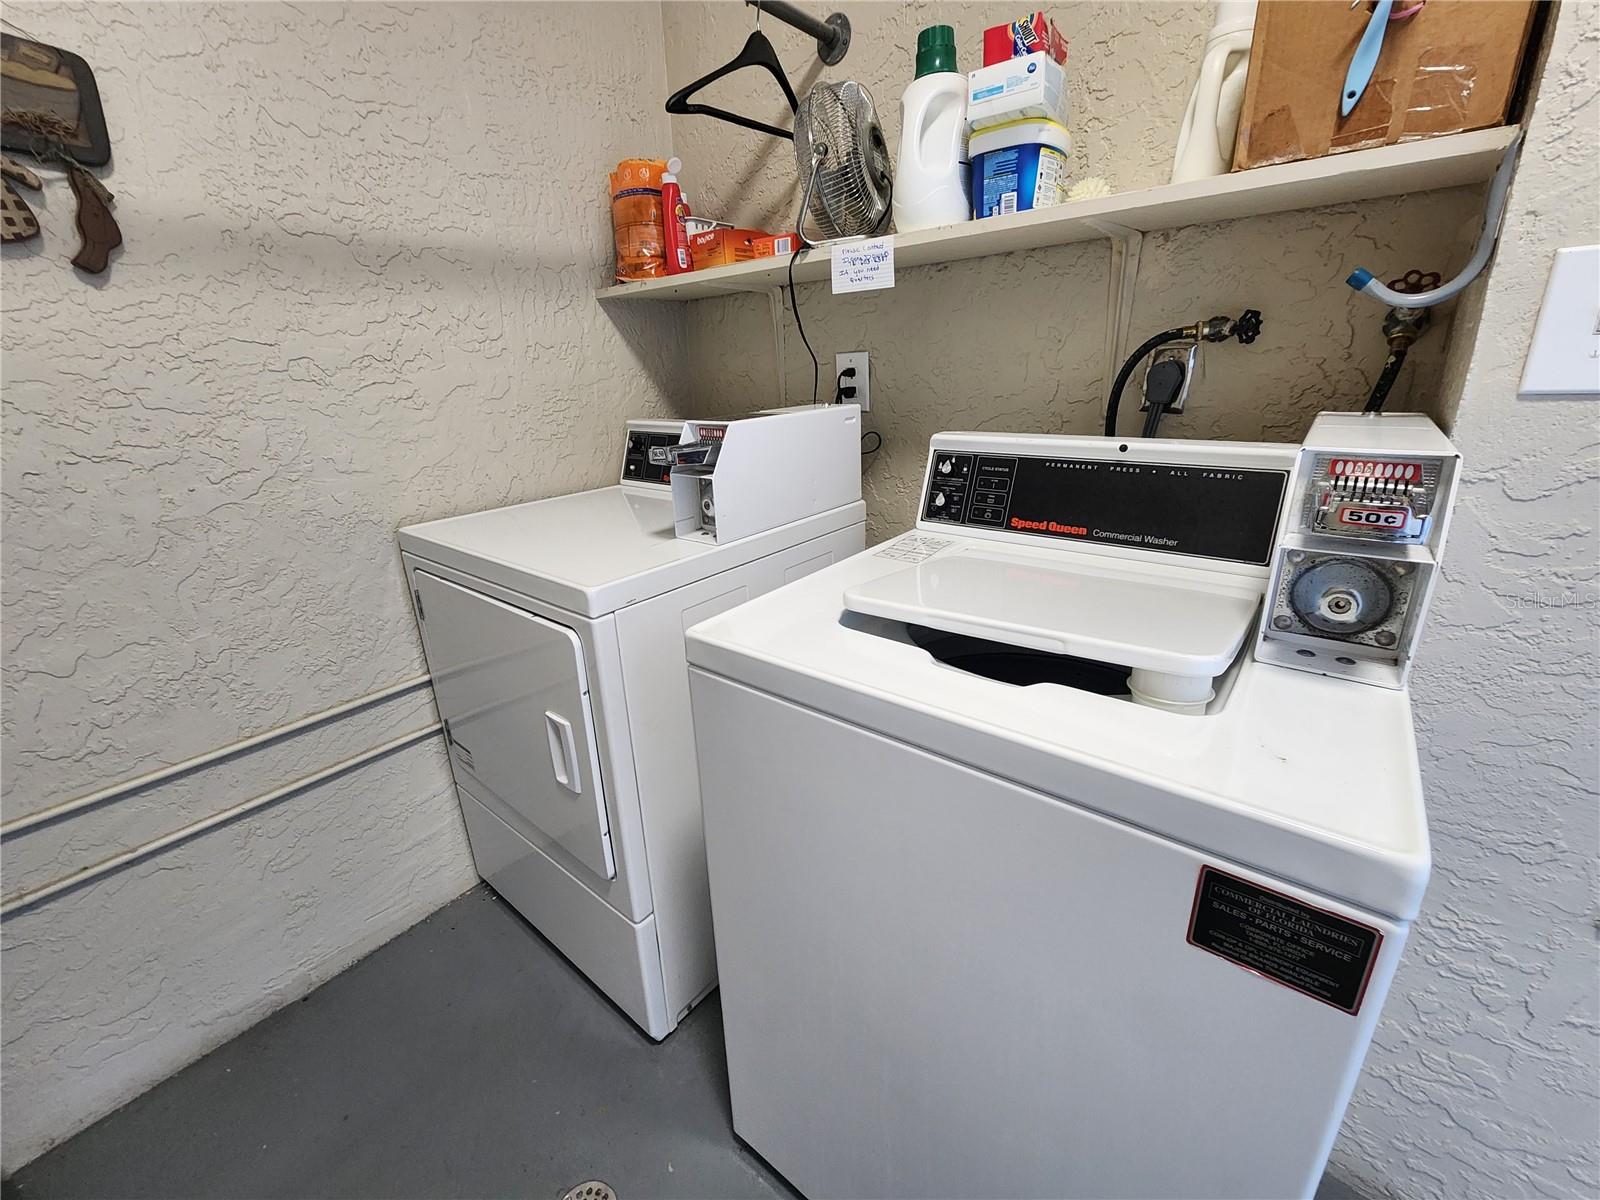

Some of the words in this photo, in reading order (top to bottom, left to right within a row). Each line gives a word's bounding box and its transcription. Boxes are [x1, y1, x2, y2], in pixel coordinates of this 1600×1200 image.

[1018, 19, 1037, 45] SHOUT
[1045, 462, 1099, 471] PERMANENT
[1109, 466, 1141, 474] PRESS
[1202, 472, 1244, 481] FABRIC
[1010, 517, 1048, 531] Speed
[1049, 521, 1088, 536] Queen
[1092, 528, 1143, 543] Commercial
[1144, 535, 1179, 547] Washer
[1213, 885, 1289, 920] COMMERCIAL
[1291, 914, 1359, 947] LAUNDRIES
[1247, 905, 1264, 917] OF
[1264, 911, 1315, 937] FLORIDA
[1211, 901, 1247, 920] SALES
[1254, 918, 1291, 938] PARTS
[1298, 935, 1353, 962] SERVICE
[1285, 941, 1315, 957] OFFICE
